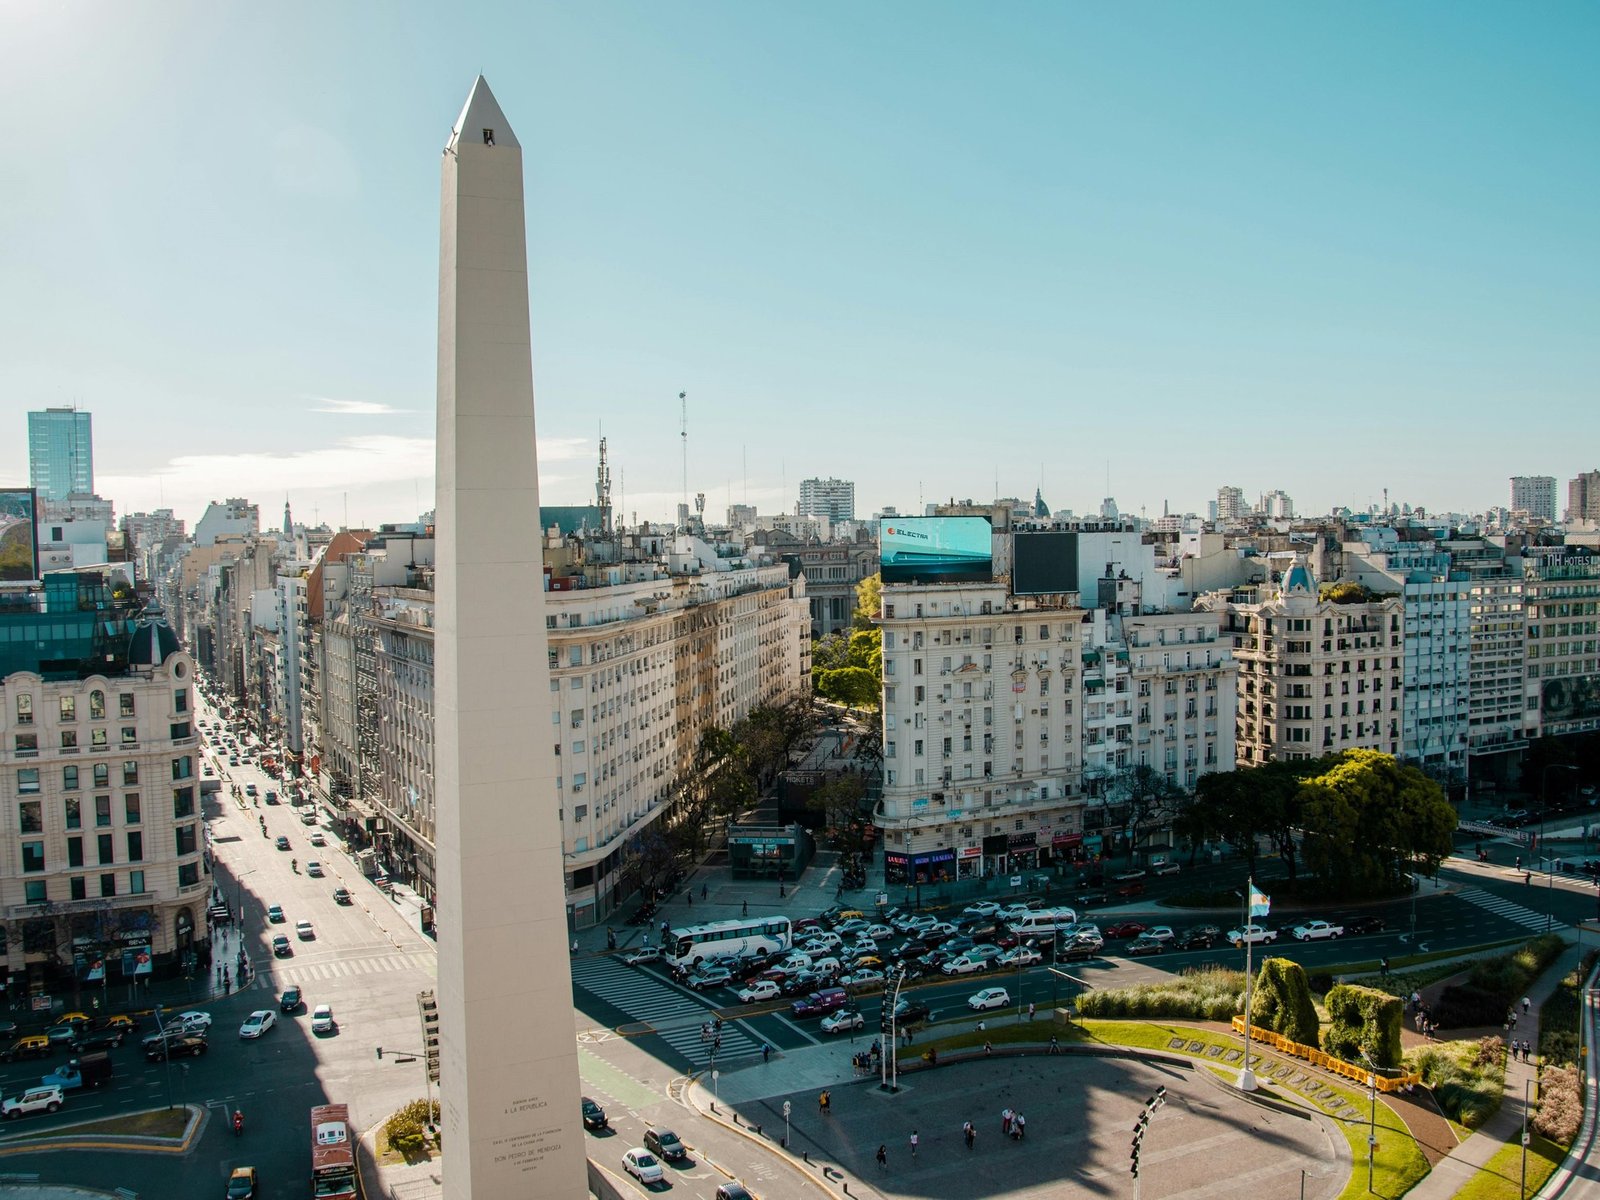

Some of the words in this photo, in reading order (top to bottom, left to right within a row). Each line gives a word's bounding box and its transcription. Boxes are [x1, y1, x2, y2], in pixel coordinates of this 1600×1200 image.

[896, 528, 928, 540] ELECTRA
[1564, 556, 1590, 566] HOTELS
[1461, 820, 1518, 835] ESTACIONAMIENTO
[510, 1106, 517, 1114] LA
[494, 1155, 507, 1163] DON
[508, 1151, 527, 1160] PEDRO
[537, 1144, 561, 1154] MENDOZA
